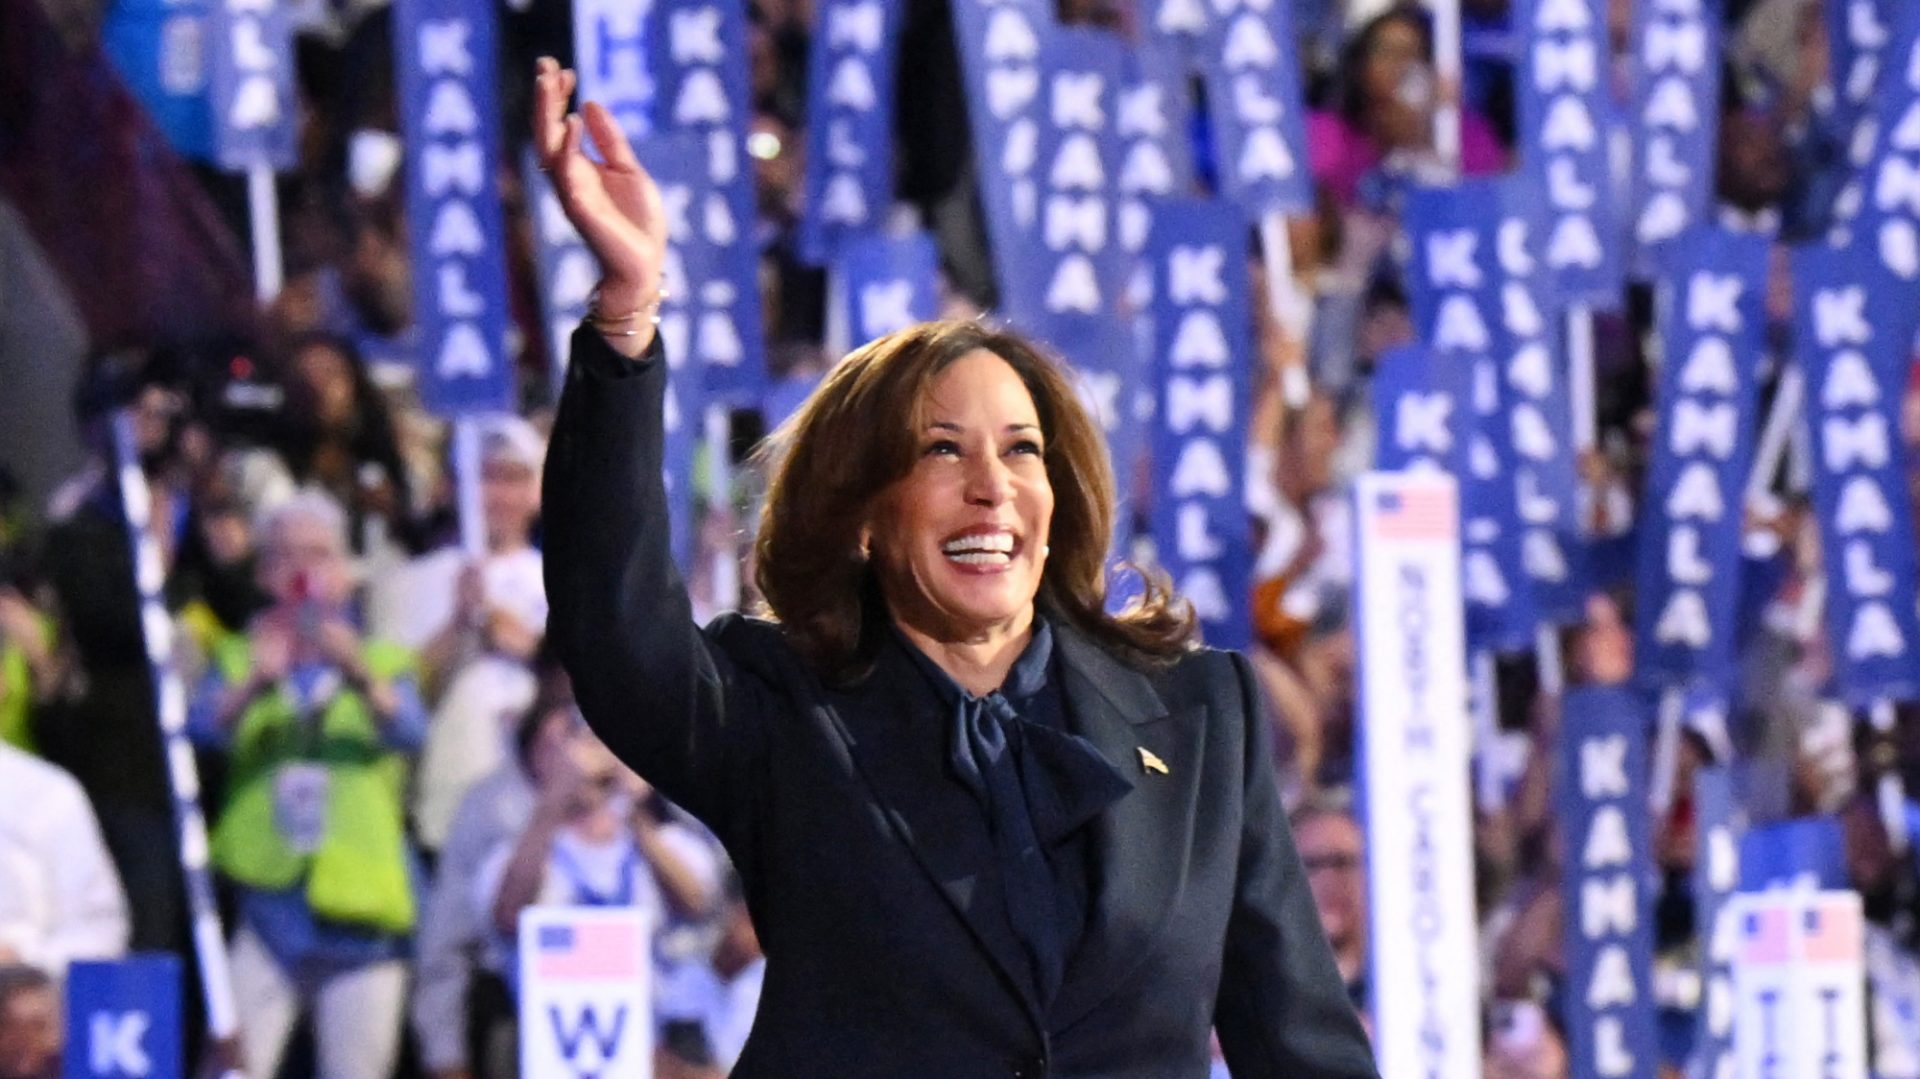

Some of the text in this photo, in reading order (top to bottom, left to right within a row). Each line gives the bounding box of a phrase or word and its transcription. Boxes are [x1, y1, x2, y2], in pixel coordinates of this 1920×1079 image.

[226, 0, 281, 128] LA
[418, 19, 492, 380] KAMALA
[1212, 0, 1296, 181] ALA
[1637, 0, 1707, 244] MALA
[1165, 243, 1234, 622] KAMALA
[1655, 270, 1745, 650] KAMALA
[1811, 286, 1907, 661] KAMALA
[1579, 733, 1642, 1076] KAMAL
